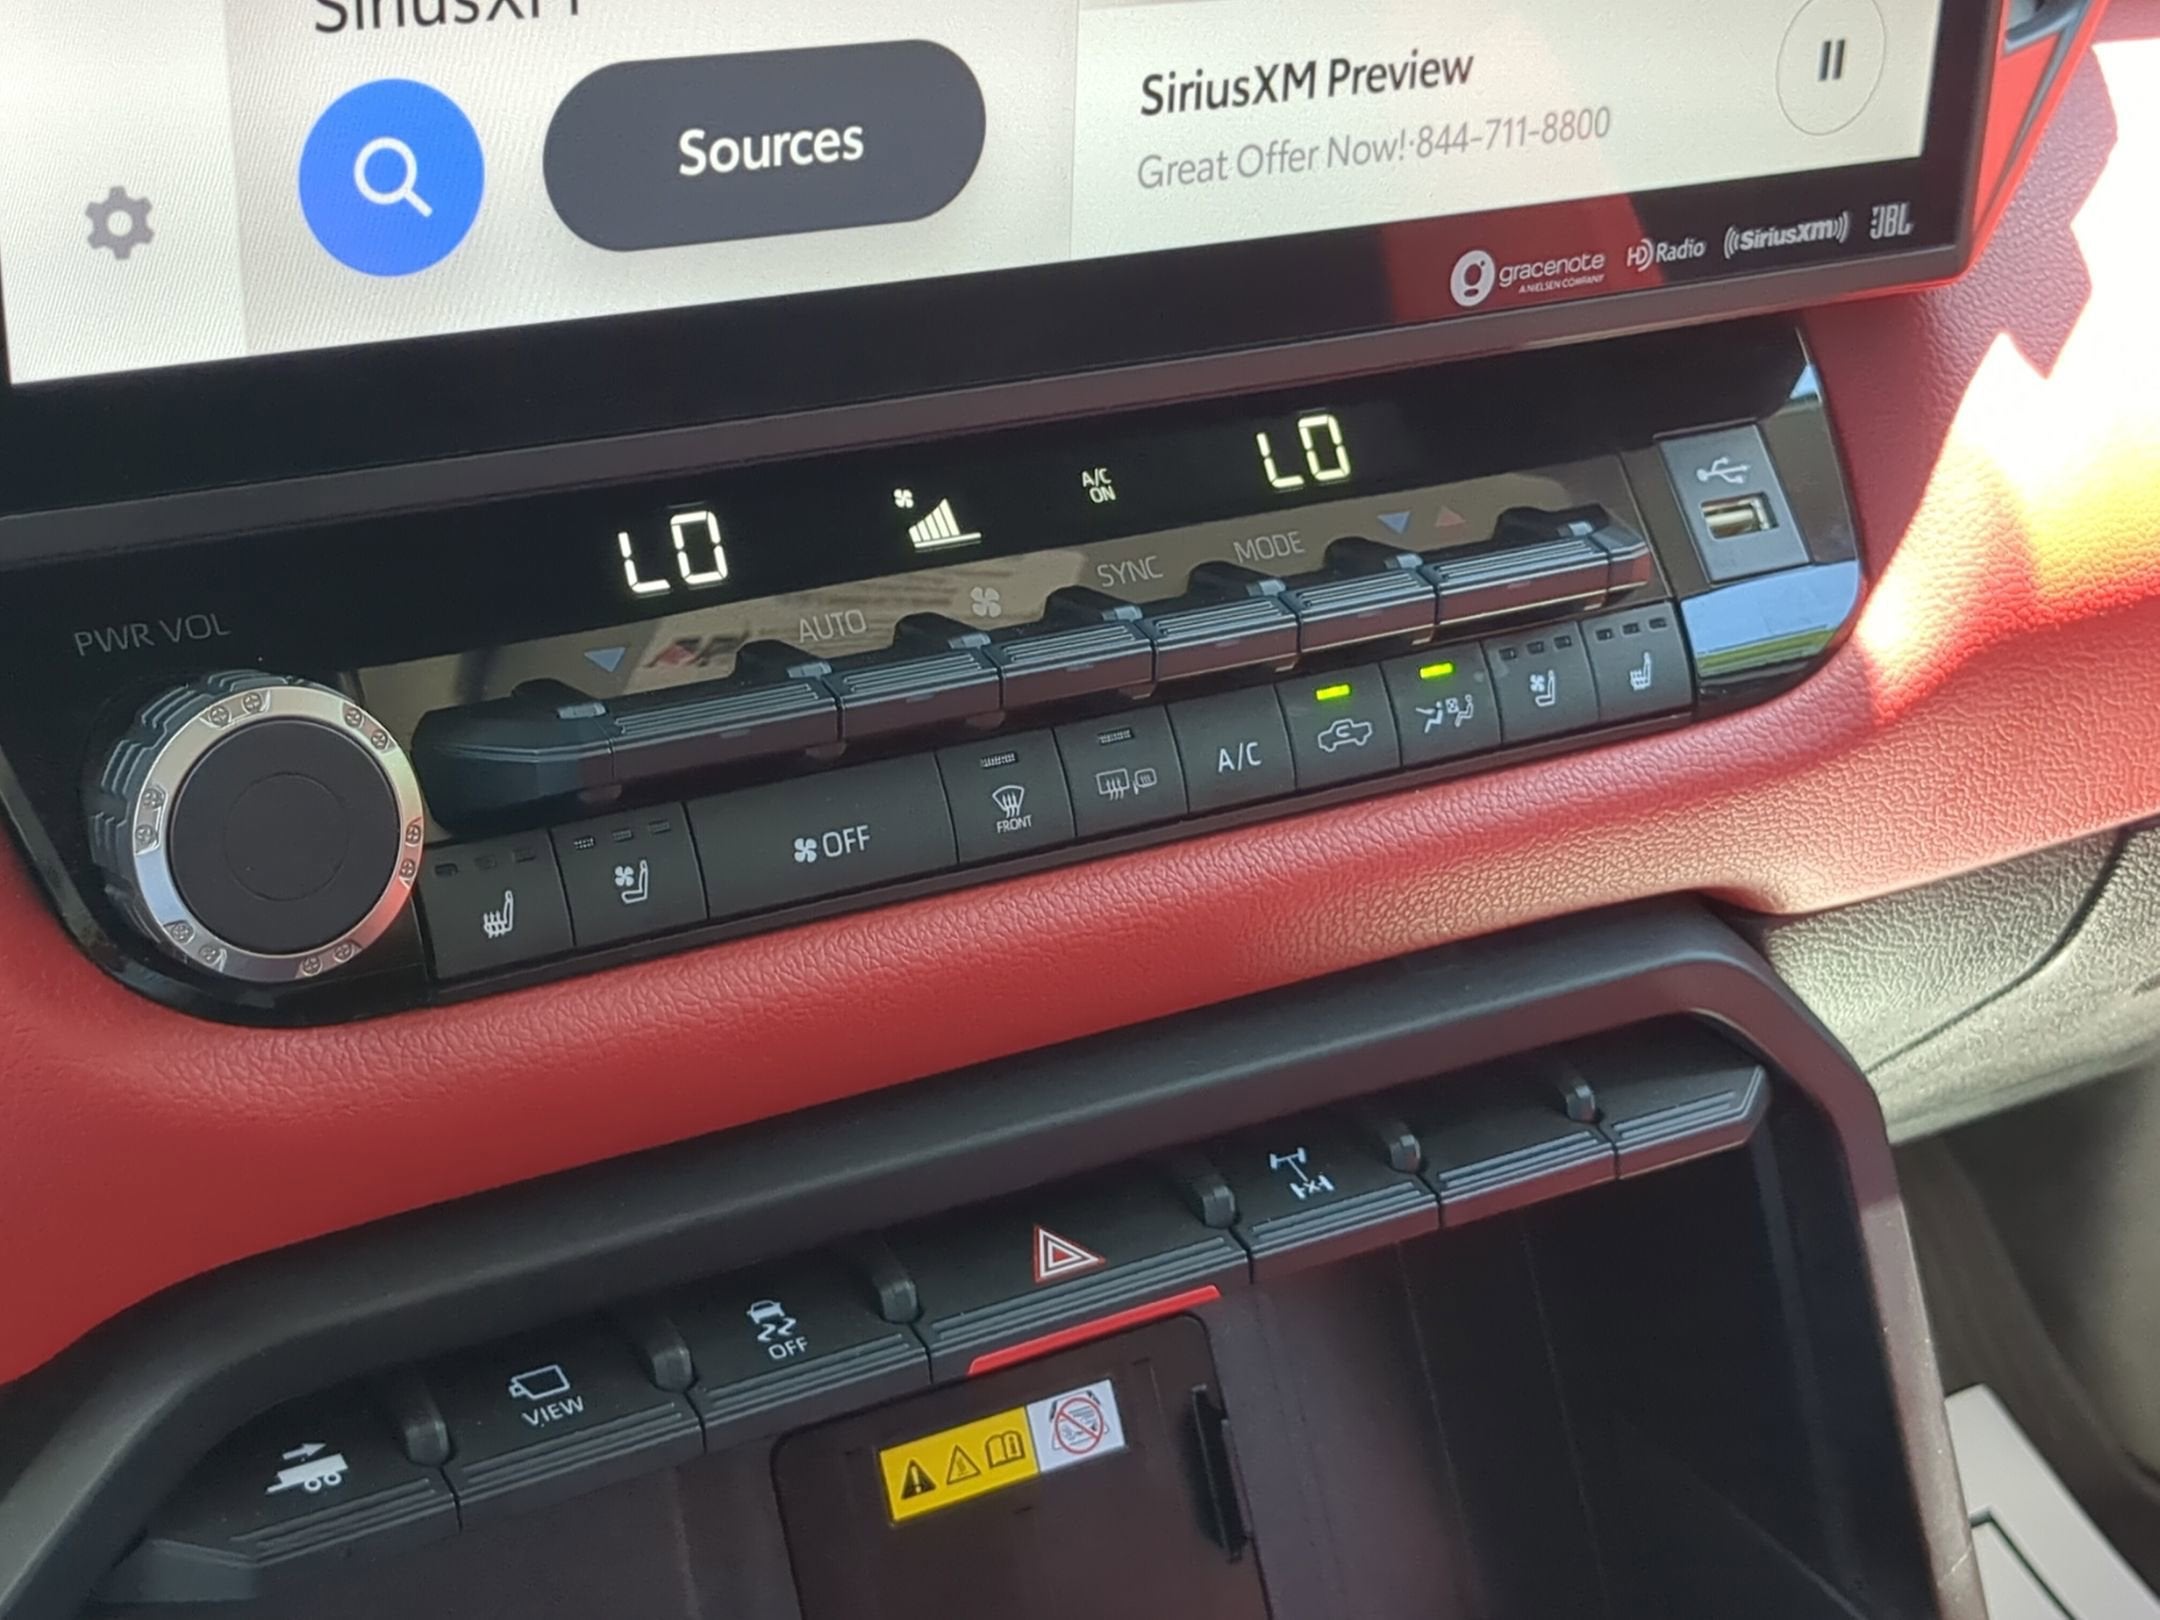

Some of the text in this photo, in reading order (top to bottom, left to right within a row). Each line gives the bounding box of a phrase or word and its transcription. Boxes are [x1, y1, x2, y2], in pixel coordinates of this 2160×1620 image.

[1140, 48, 1474, 116] SiriusXM Preview
[678, 123, 864, 177] Sources
[1138, 150, 1228, 189] Great
[1237, 139, 1320, 178] Offer
[1870, 202, 1913, 239] JBL
[1656, 237, 1706, 263] Radio
[1499, 253, 1605, 287] gracenote
[1256, 414, 1351, 489] LO
[1081, 467, 1112, 487] A/C
[1089, 486, 1116, 504] ON
[618, 510, 728, 594] LO
[1233, 531, 1305, 564] MODE
[1096, 555, 1164, 589] SYNC
[74, 613, 231, 656] PWR VOL
[799, 609, 868, 644] AUTO
[1217, 741, 1262, 773] A/C
[996, 814, 1033, 833] FRONT
[822, 825, 871, 858] OFF
[768, 1337, 809, 1360] OFF
[522, 1396, 585, 1427] VIEW
